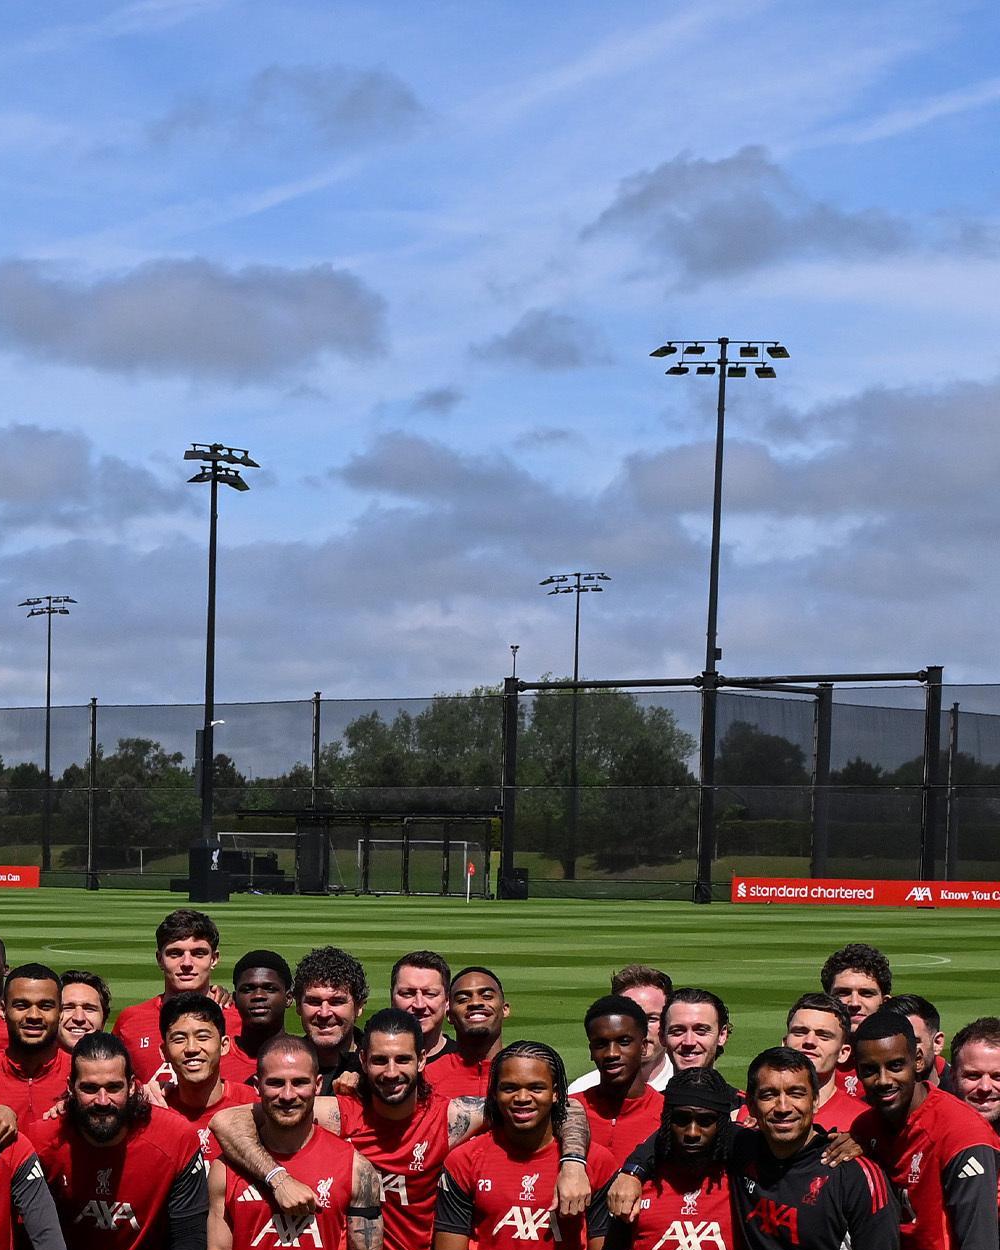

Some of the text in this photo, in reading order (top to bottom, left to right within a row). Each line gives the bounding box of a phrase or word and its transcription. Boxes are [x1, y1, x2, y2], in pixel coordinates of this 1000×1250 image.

[7, 873, 20, 882] Can
[750, 884, 874, 900] standard chartered
[905, 886, 933, 902] AXA
[940, 889, 970, 900] Know
[971, 890, 990, 900] You
[140, 1037, 150, 1049] 15
[478, 1179, 492, 1192] 73
[73, 1200, 141, 1231] AXA
[492, 1205, 563, 1242] AXA
[747, 1197, 800, 1245] AXA
[250, 1213, 324, 1248] AXA
